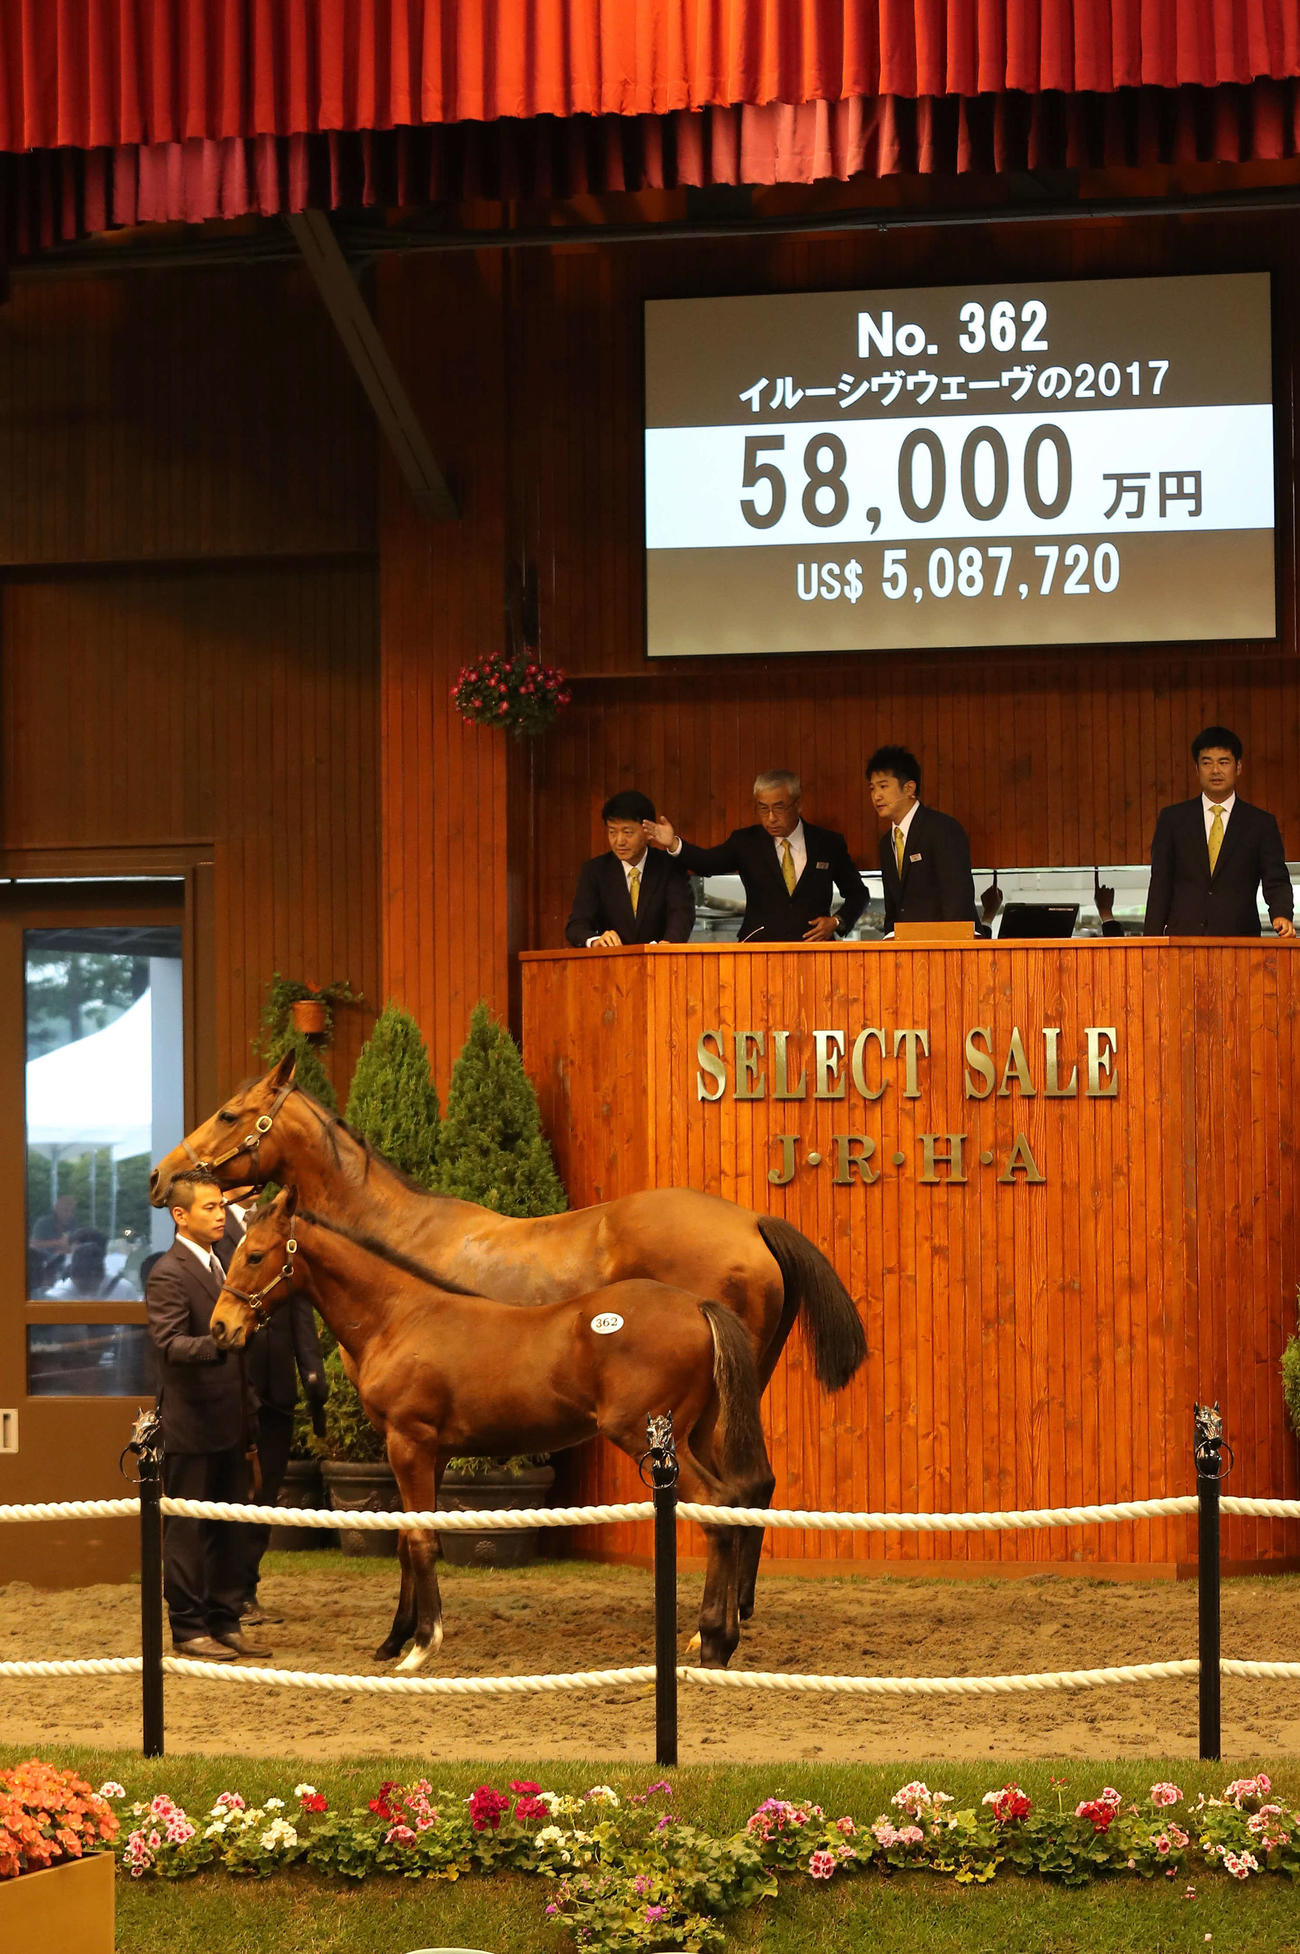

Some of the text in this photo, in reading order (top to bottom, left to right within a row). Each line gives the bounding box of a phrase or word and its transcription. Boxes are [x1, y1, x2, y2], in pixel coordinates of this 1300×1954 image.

[857, 300, 1049, 358] No. 362
[739, 360, 1170, 412] イルーシヴウェーヴの2017
[740, 423, 1203, 535] 58,000 万円
[797, 542, 1120, 604] US$ 5,087,720
[697, 1026, 1118, 1101] SELECT SALE
[595, 1317, 618, 1328] 362
